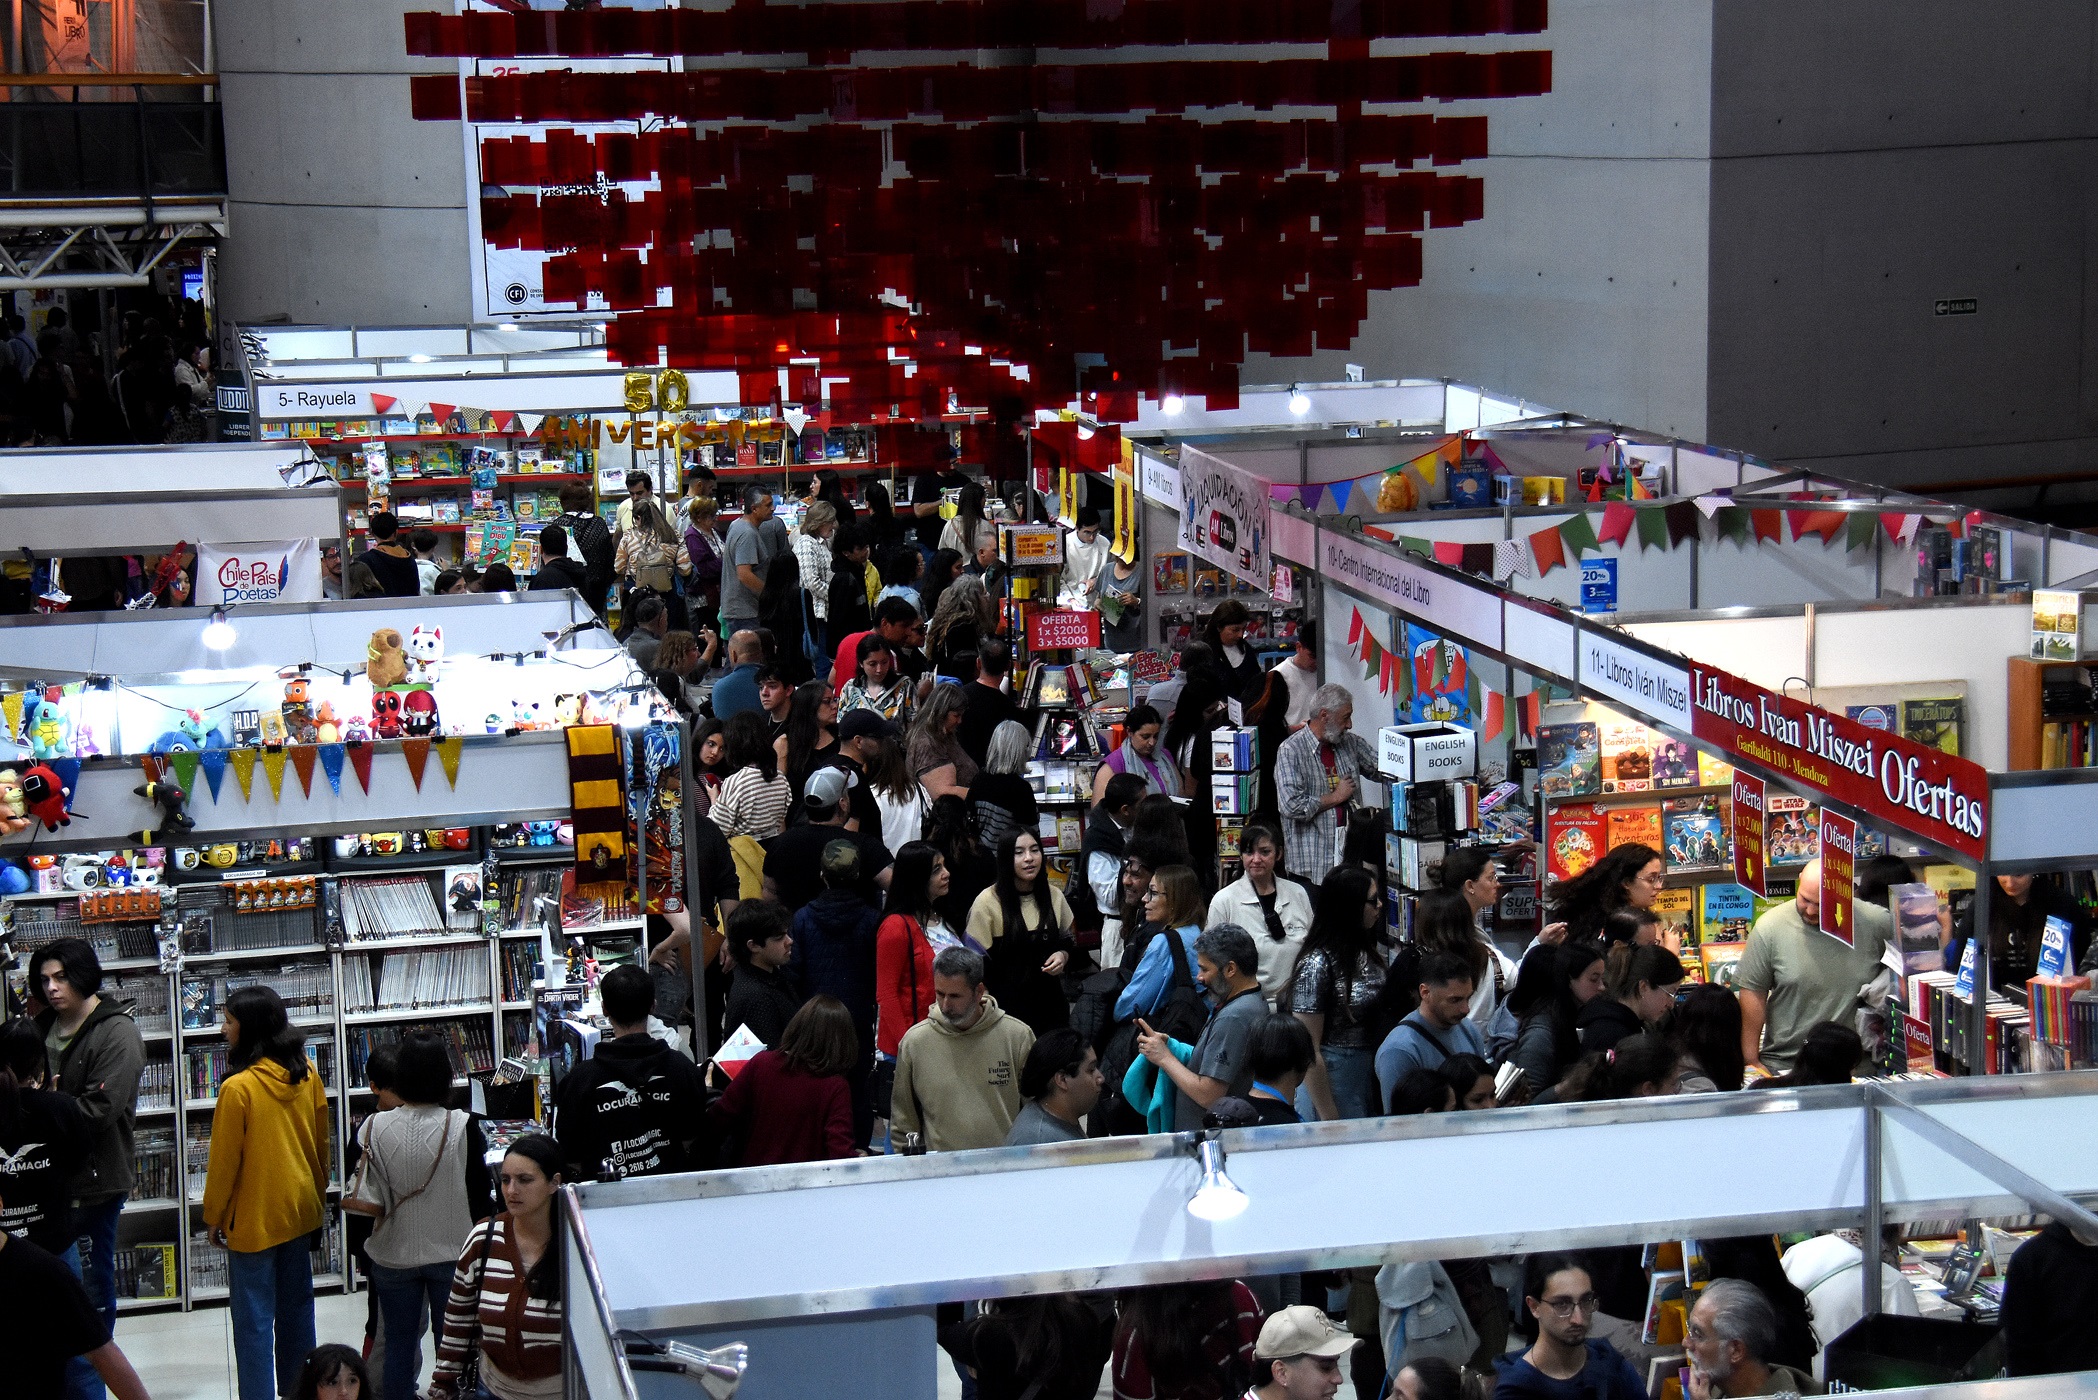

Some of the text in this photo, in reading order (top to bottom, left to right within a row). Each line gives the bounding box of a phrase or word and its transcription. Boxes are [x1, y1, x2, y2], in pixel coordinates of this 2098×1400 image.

[509, 287, 523, 299] CFI
[1950, 302, 1976, 311] SALIDA
[624, 368, 690, 413] 50
[279, 390, 356, 410] 5- Rayuela
[1161, 474, 1173, 496] libros
[1196, 474, 1251, 538] LIQUIDACIÓN
[1210, 514, 1234, 544] AM Libros
[218, 558, 277, 588] Chile País
[1338, 548, 1359, 577] Centro
[1360, 555, 1400, 594] Internacional
[1401, 575, 1413, 598] del
[1413, 578, 1430, 606] Libro
[1582, 570, 1606, 582] 20%
[240, 582, 250, 590] de
[1589, 586, 1596, 597] 3
[222, 588, 278, 606] Poetas
[1042, 614, 1081, 624] OFERTA
[1038, 627, 1042, 636] 1
[1053, 625, 1088, 636] $2000
[1038, 638, 1044, 647] 3
[1055, 636, 1089, 647] $5000
[1591, 648, 1687, 714] 11- Libros Iván Miszei
[1385, 734, 1406, 748] ENGLISH
[1425, 739, 1466, 752] ENGLISH
[1604, 738, 1646, 746] Completa
[1387, 751, 1404, 764] BOOKS
[1693, 668, 1982, 840] Libros Ivan Miszei Ofertas
[1736, 734, 1828, 787] Garibaldi 110 Mendoza
[1428, 756, 1462, 768] BOOKS
[1734, 781, 1762, 812] Oferta
[1612, 832, 1660, 845] Aventuras
[1824, 822, 1852, 854] Oferta
[1506, 906, 1536, 916] OFERT
[2044, 930, 2062, 944] 20%
[2044, 950, 2050, 961] 6
[1960, 970, 1968, 981] 6
[544, 992, 580, 1002] DARTH VADER
[1906, 1022, 1930, 1046] Oferta
